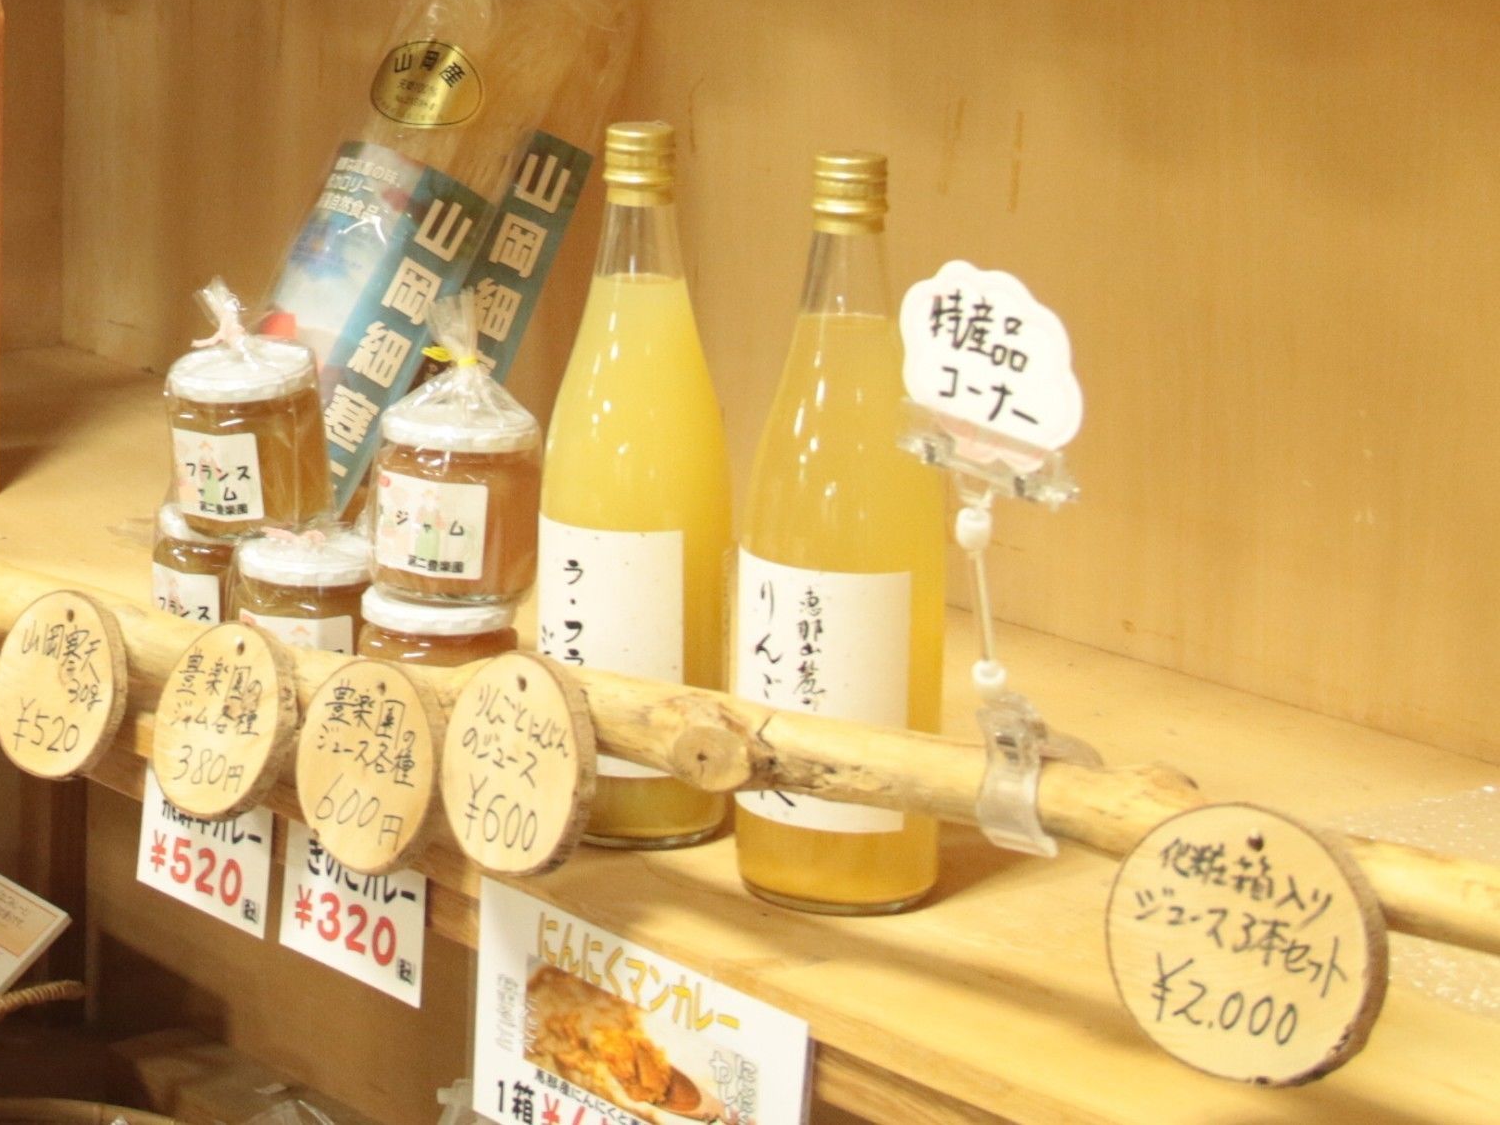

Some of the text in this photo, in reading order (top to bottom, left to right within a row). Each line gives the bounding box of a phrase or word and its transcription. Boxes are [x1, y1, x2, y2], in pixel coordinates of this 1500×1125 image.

[322, 198, 474, 481] 山岡細寒
[929, 288, 1029, 372] 特産品
[938, 366, 1039, 422] コーナー
[12, 698, 80, 752] ¥520
[172, 744, 245, 793] 380円
[315, 774, 404, 851] 600円
[465, 773, 538, 853] ¥600
[150, 829, 243, 907] ¥520
[1160, 837, 1332, 928] 化粧箱入り
[294, 884, 397, 967] ¥320
[1135, 888, 1349, 999] ジュース3本セット
